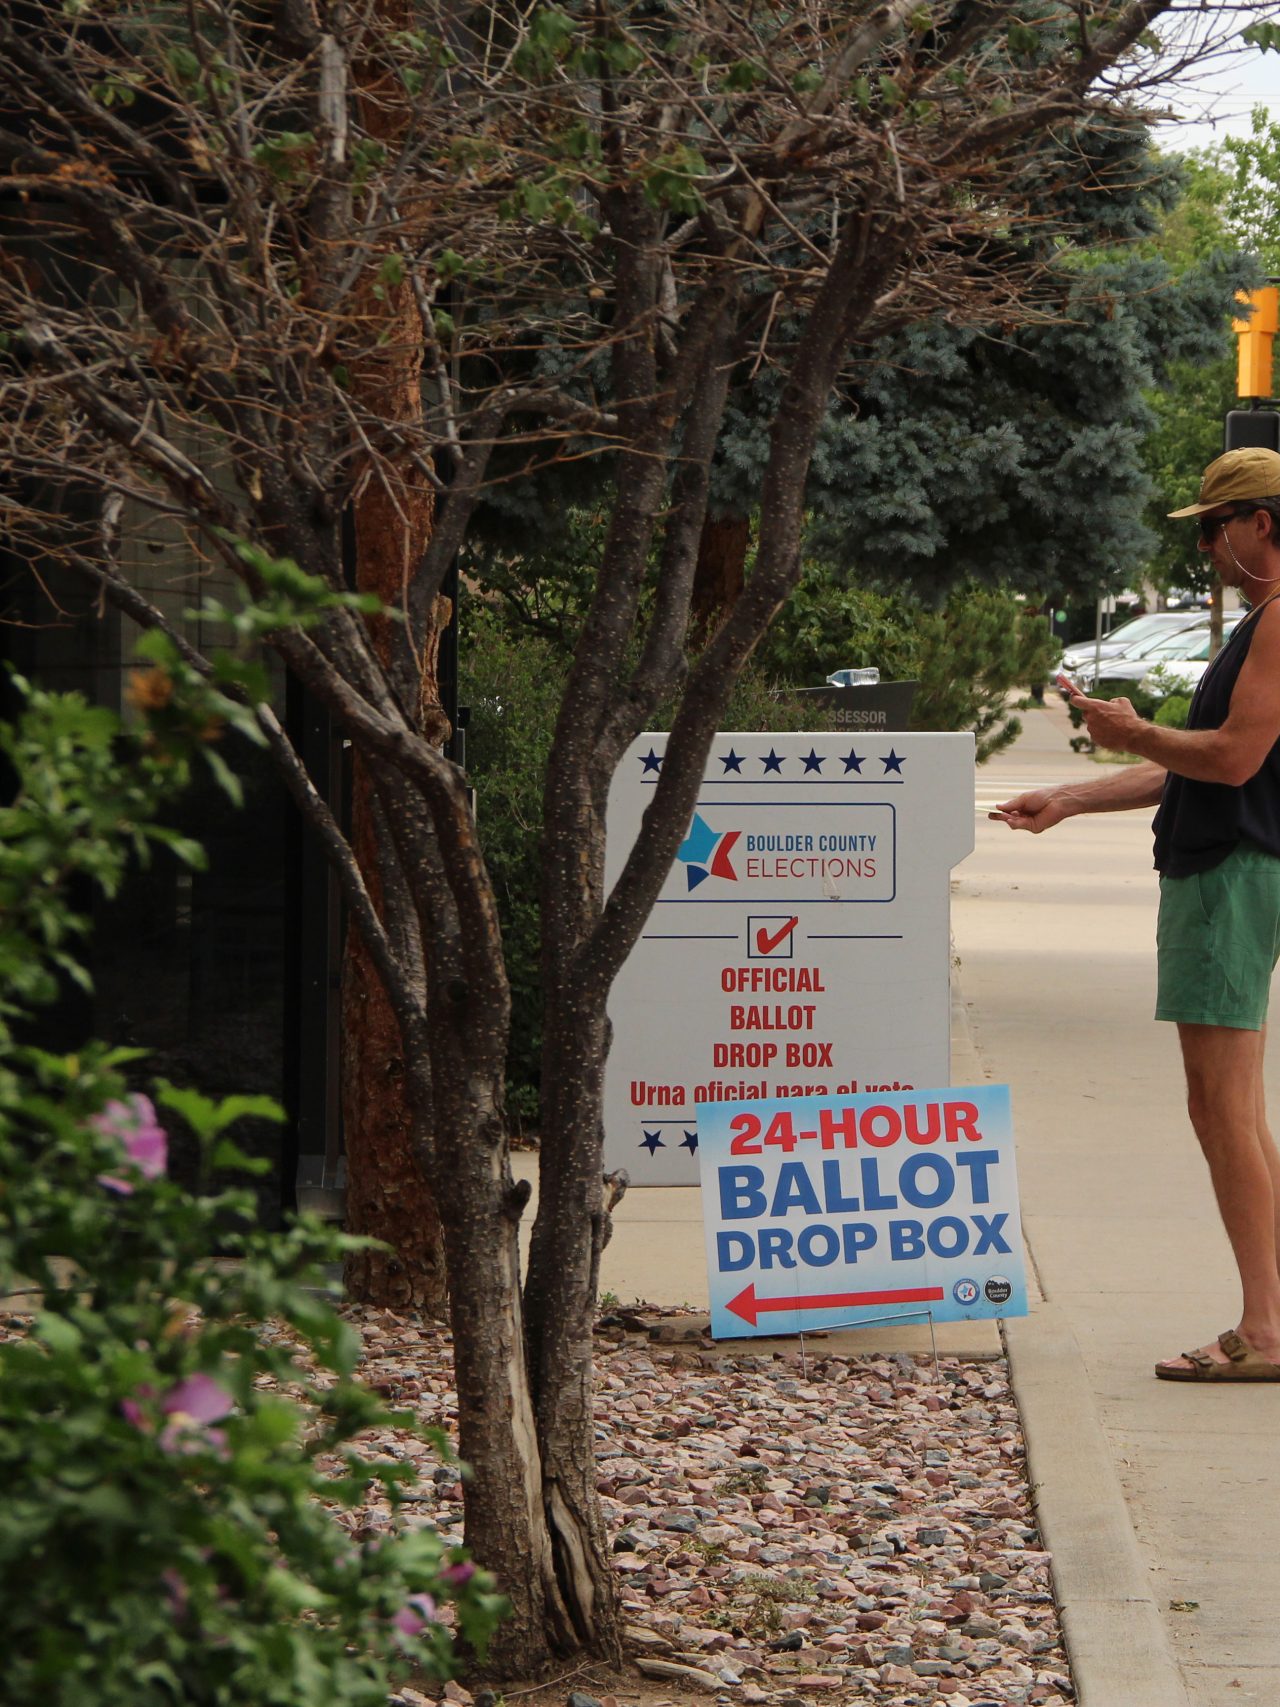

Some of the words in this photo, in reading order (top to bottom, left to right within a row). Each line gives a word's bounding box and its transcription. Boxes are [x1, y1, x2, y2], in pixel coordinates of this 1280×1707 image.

[746, 835, 814, 852] BOULDER
[819, 835, 877, 852] COUNTY
[746, 858, 877, 878] ELECTIONS
[721, 967, 825, 993] OFFICIAL
[730, 1005, 817, 1031] BALLOT
[713, 1043, 778, 1068] DROP
[786, 1043, 833, 1068] BOX
[630, 1081, 686, 1106] Urna
[694, 1081, 767, 1103] oficial
[729, 1101, 983, 1155] 24-HOUR
[718, 1150, 1000, 1220] BALLOT
[717, 1223, 878, 1272] DROP
[889, 1213, 1012, 1261] BOX
